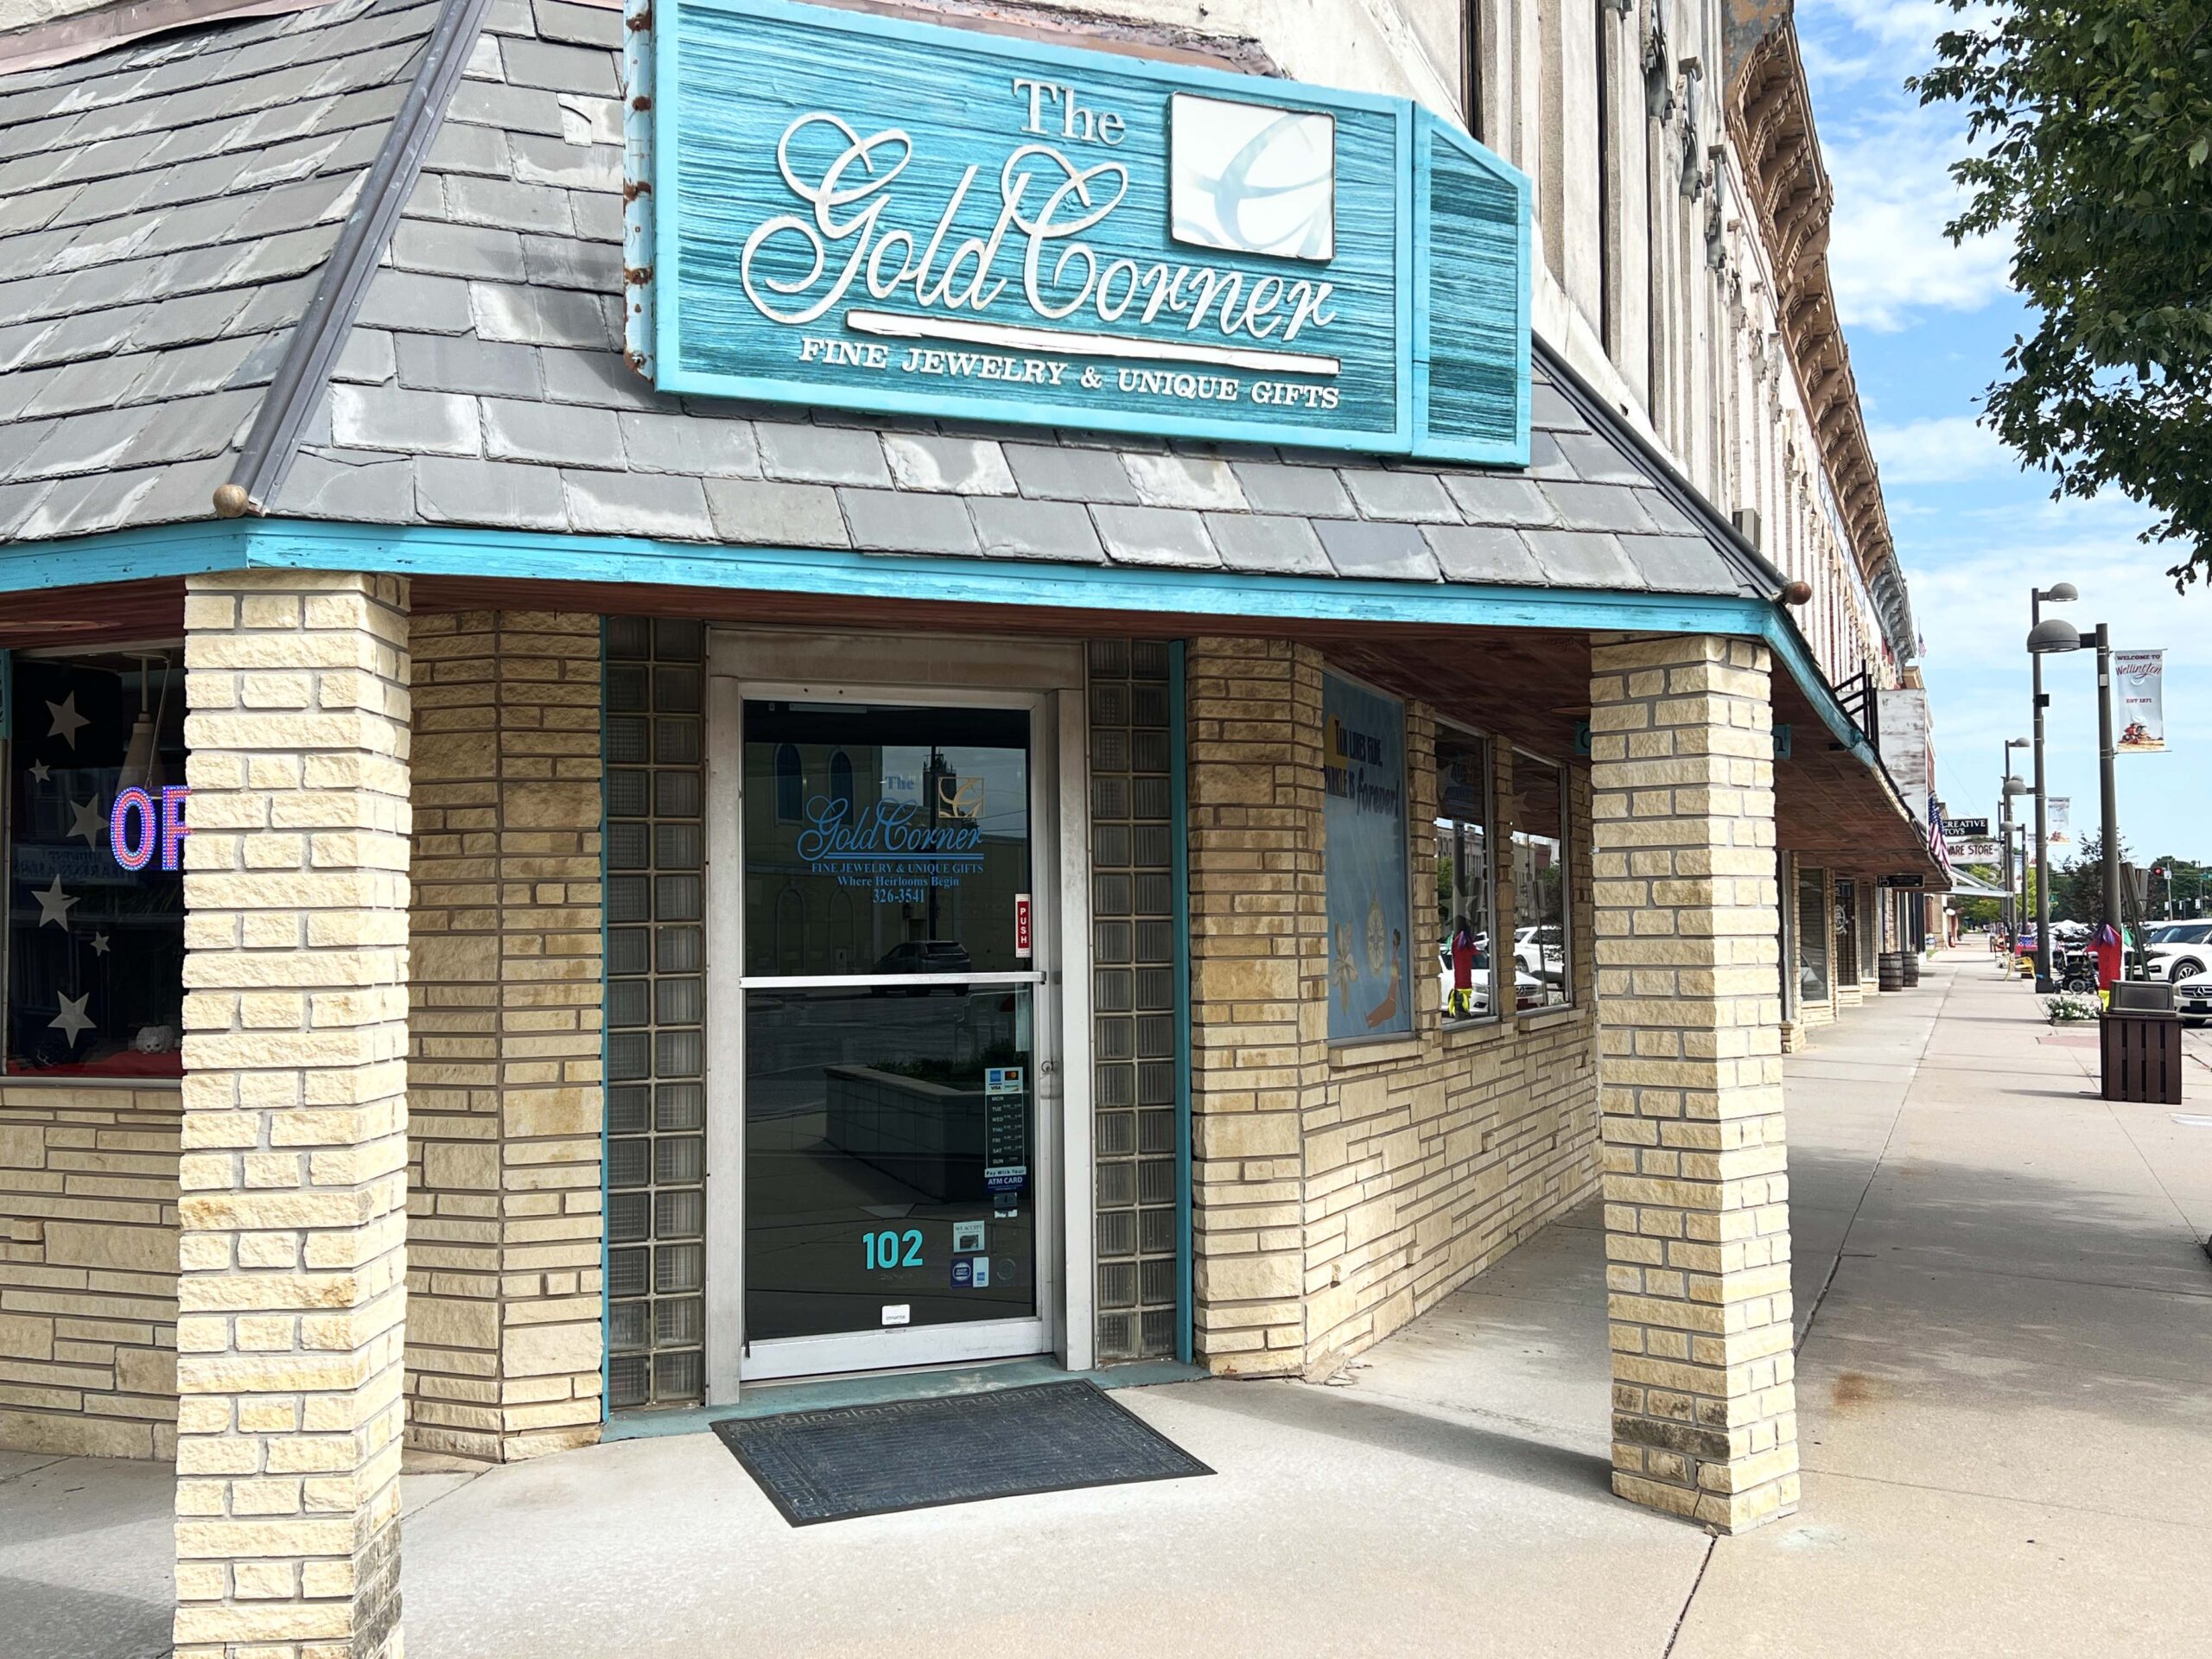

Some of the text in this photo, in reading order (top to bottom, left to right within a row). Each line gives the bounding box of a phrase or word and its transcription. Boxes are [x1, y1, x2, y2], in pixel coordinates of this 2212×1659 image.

[1014, 78, 1126, 145] The
[741, 111, 1337, 342] Gold Corner
[798, 337, 1339, 410] FINE JEWELRY & UNIQUE GIFTS
[2115, 662, 2162, 679] Wellington
[884, 775, 914, 790] The
[797, 796, 982, 861] Gold Corner
[812, 863, 983, 874] FINE JEWELRY & UNIQUE GIFTS
[837, 876, 959, 888] Where Heirlooms Begin
[873, 888, 925, 903] 326-3541
[862, 1230, 923, 1269] 102
